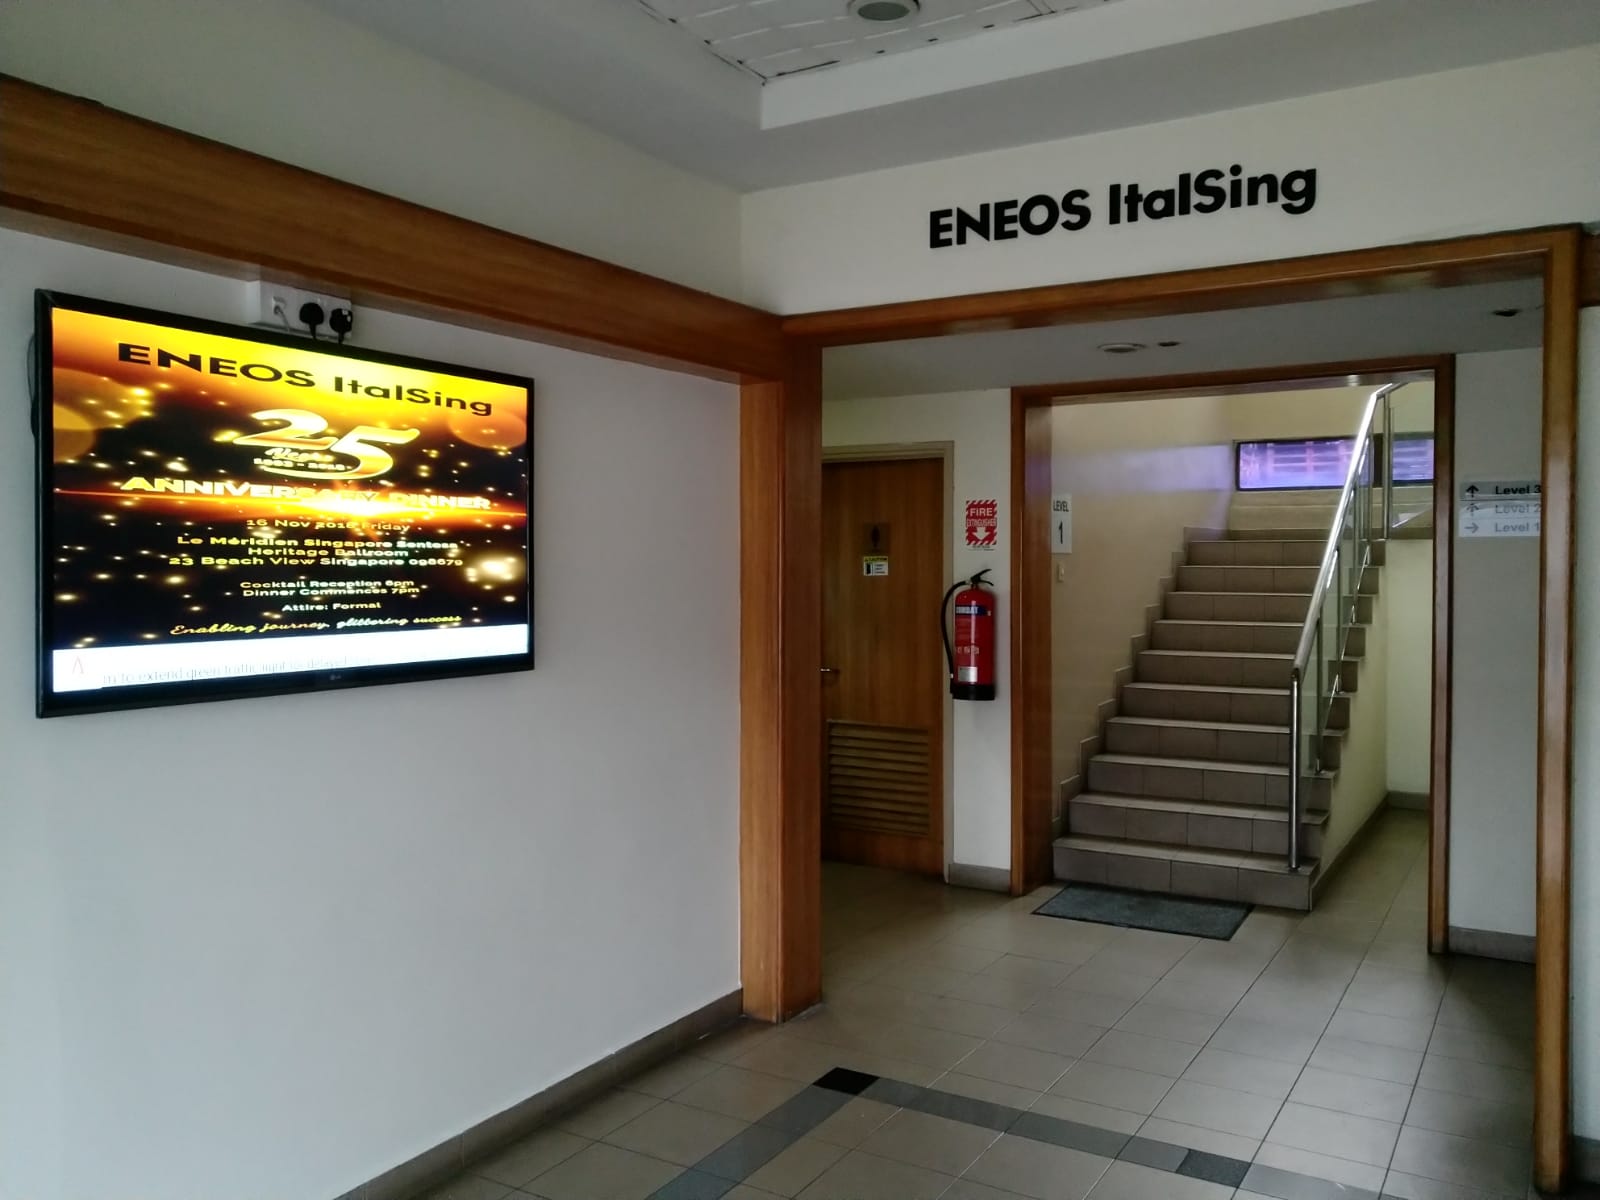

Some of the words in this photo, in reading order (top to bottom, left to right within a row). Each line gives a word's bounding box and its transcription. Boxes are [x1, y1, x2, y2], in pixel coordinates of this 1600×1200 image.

[930, 189, 1091, 248] ENEOS
[1109, 164, 1317, 225] ItalSing
[118, 342, 313, 387] ENEOS
[334, 376, 493, 417] ItalSing
[233, 408, 420, 479] 25
[120, 476, 380, 503] ANNIVERSARY
[389, 492, 491, 510] DINNER
[1495, 485, 1531, 495] Level
[1534, 485, 1541, 494] 3
[969, 507, 994, 517] FIRE
[1053, 500, 1069, 513] LEVEL
[1495, 503, 1530, 514] Level
[1534, 503, 1541, 512] 2
[274, 519, 310, 528] Nov
[361, 522, 411, 532] Friday
[1495, 522, 1530, 532] Level
[1535, 522, 1541, 531] 1
[1058, 520, 1063, 545] 1
[177, 536, 203, 545] Le
[303, 538, 393, 549] Singapore
[247, 547, 329, 557] Heritage
[334, 548, 409, 557] Ballroom
[169, 557, 194, 566] 23
[201, 556, 264, 565] Beach
[270, 557, 316, 565] View
[319, 557, 405, 567] Singapore
[310, 580, 382, 589] Reception
[385, 580, 415, 588] 6pm
[243, 589, 296, 597] Dinner
[391, 586, 420, 594] 7pm
[281, 603, 329, 612] Attire:
[332, 601, 381, 610] Formal
[170, 622, 257, 635] Enabling
